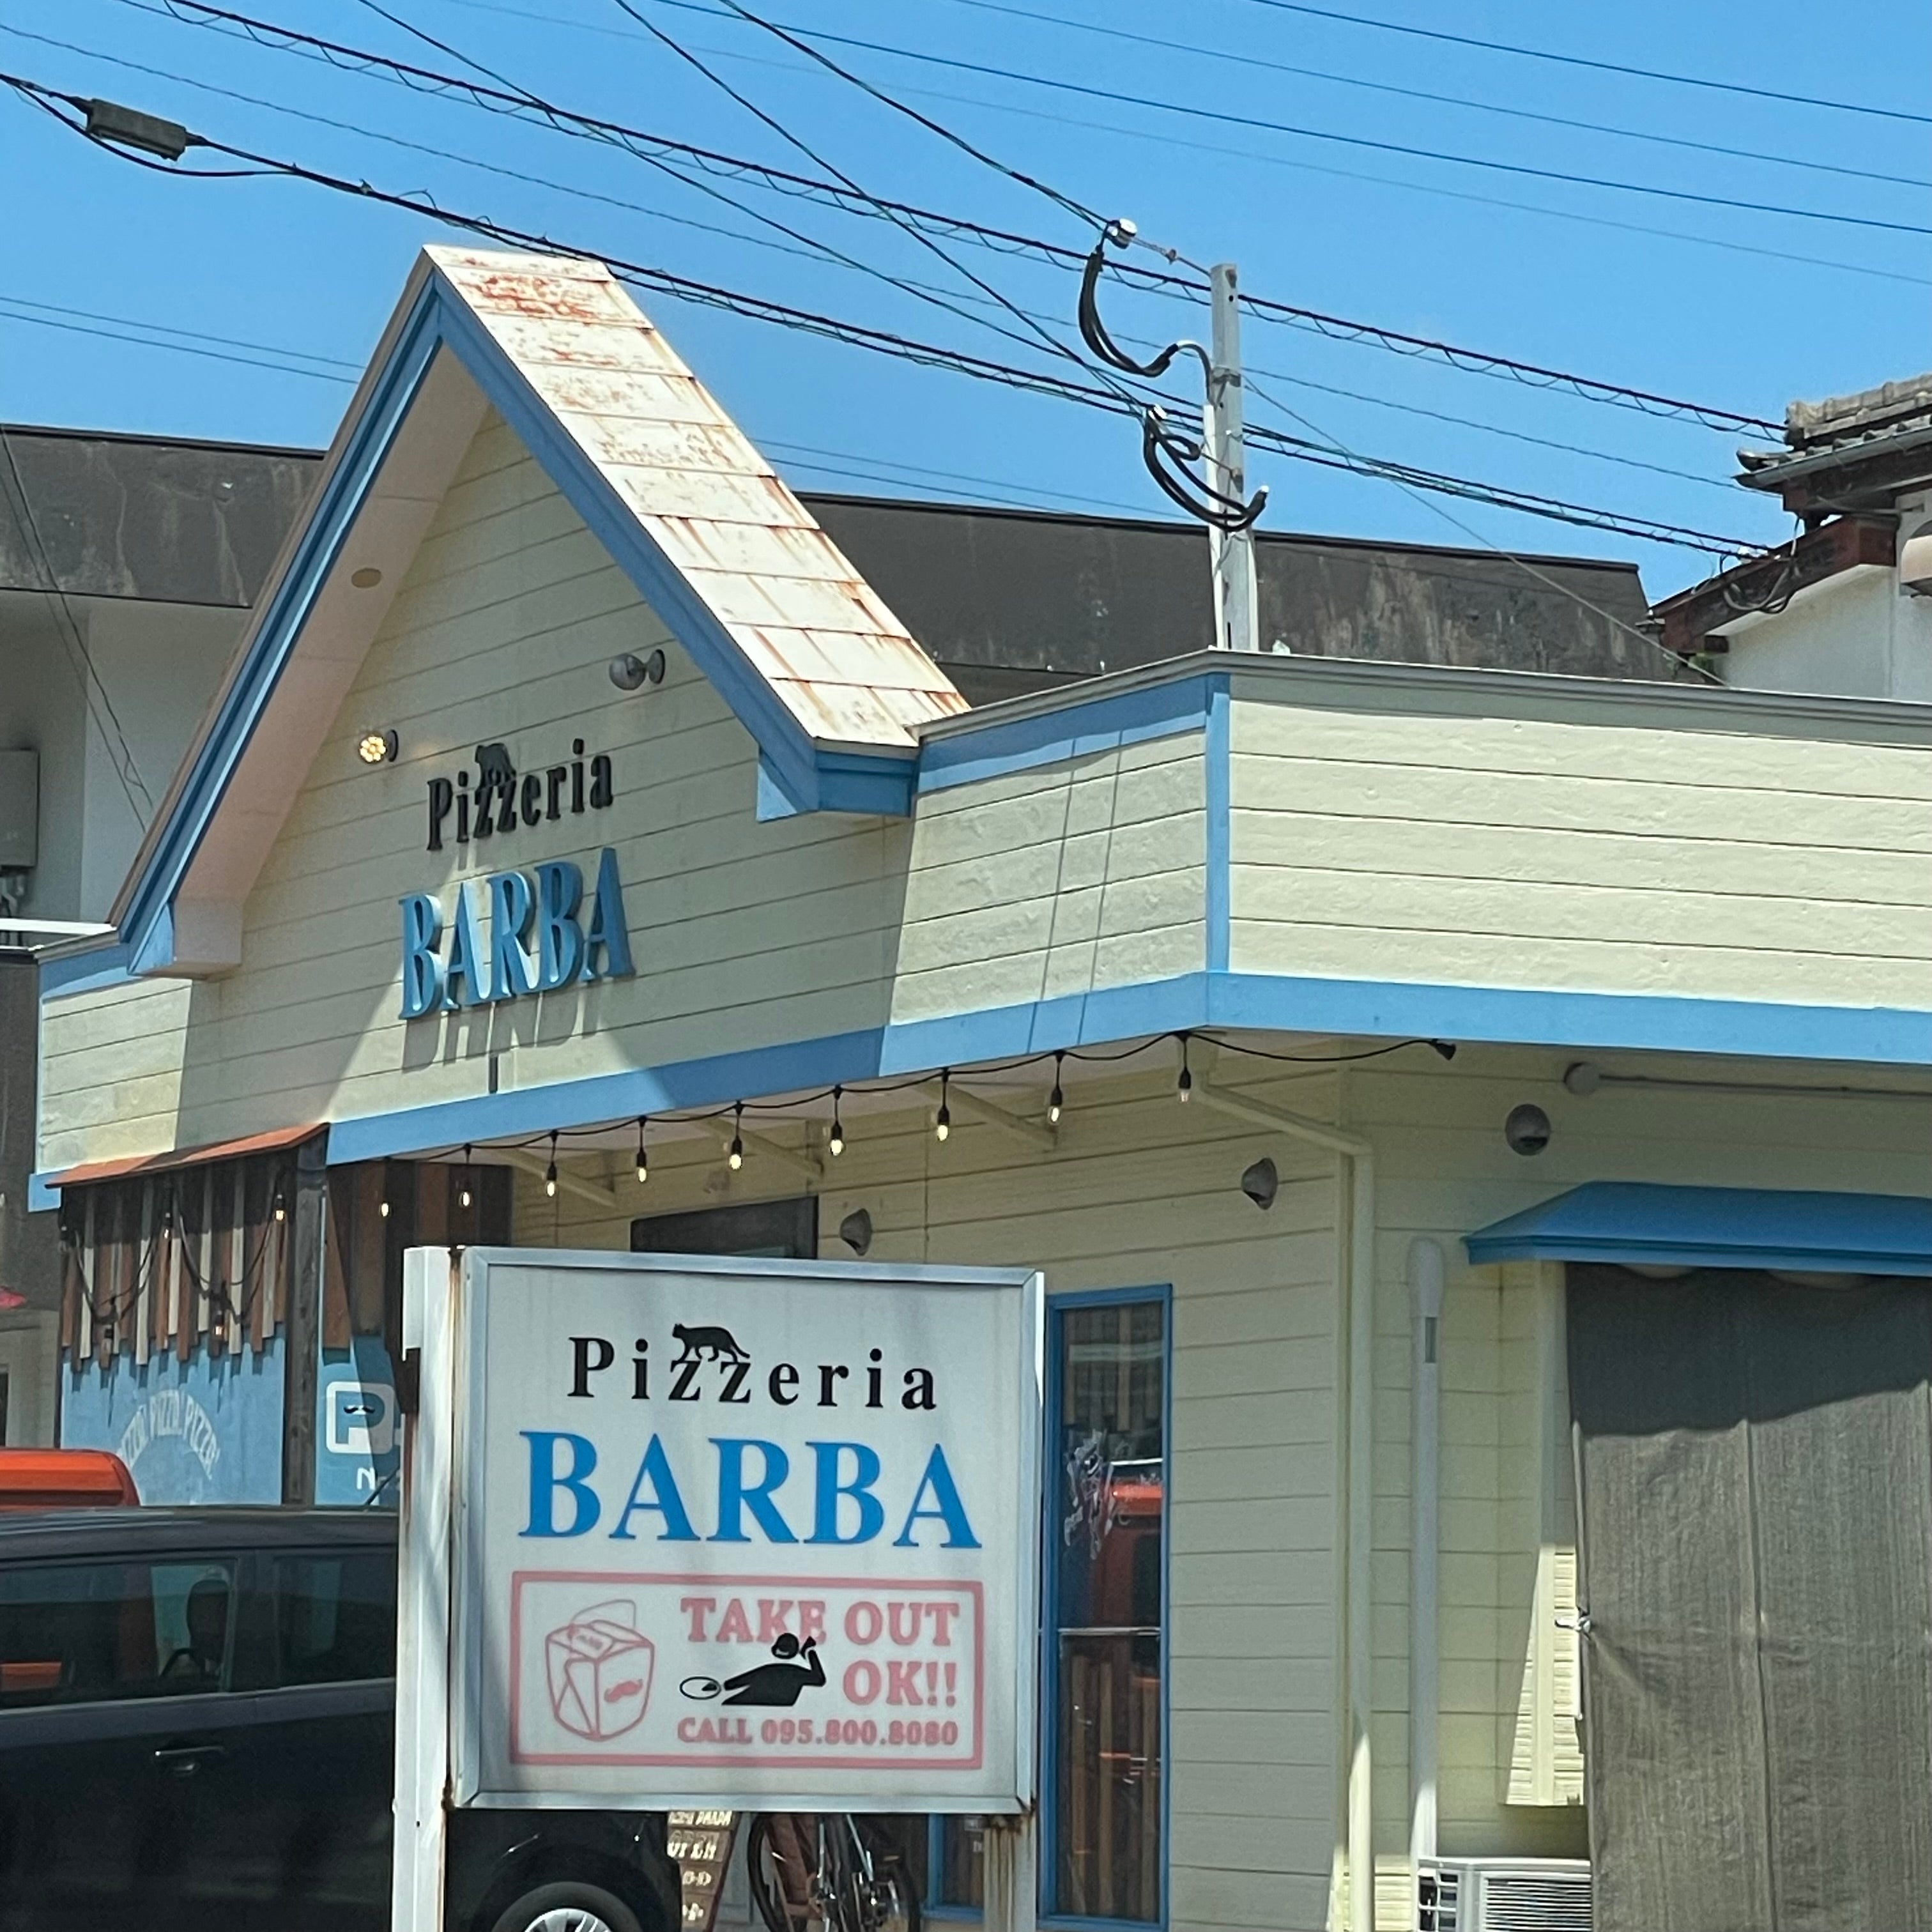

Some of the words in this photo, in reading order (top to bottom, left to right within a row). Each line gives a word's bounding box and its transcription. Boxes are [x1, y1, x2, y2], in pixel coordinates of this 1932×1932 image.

[427, 738, 614, 851] Pizzeria
[399, 847, 636, 1020] BARBA
[567, 1336, 937, 1410] Pizzeria
[518, 1431, 983, 1549] BARBA
[680, 1597, 827, 1644] TAKE
[843, 1601, 960, 1646] OUT
[842, 1659, 957, 1706] OK!!
[677, 1717, 753, 1744] CALL
[760, 1719, 959, 1745] 095.800.8080
